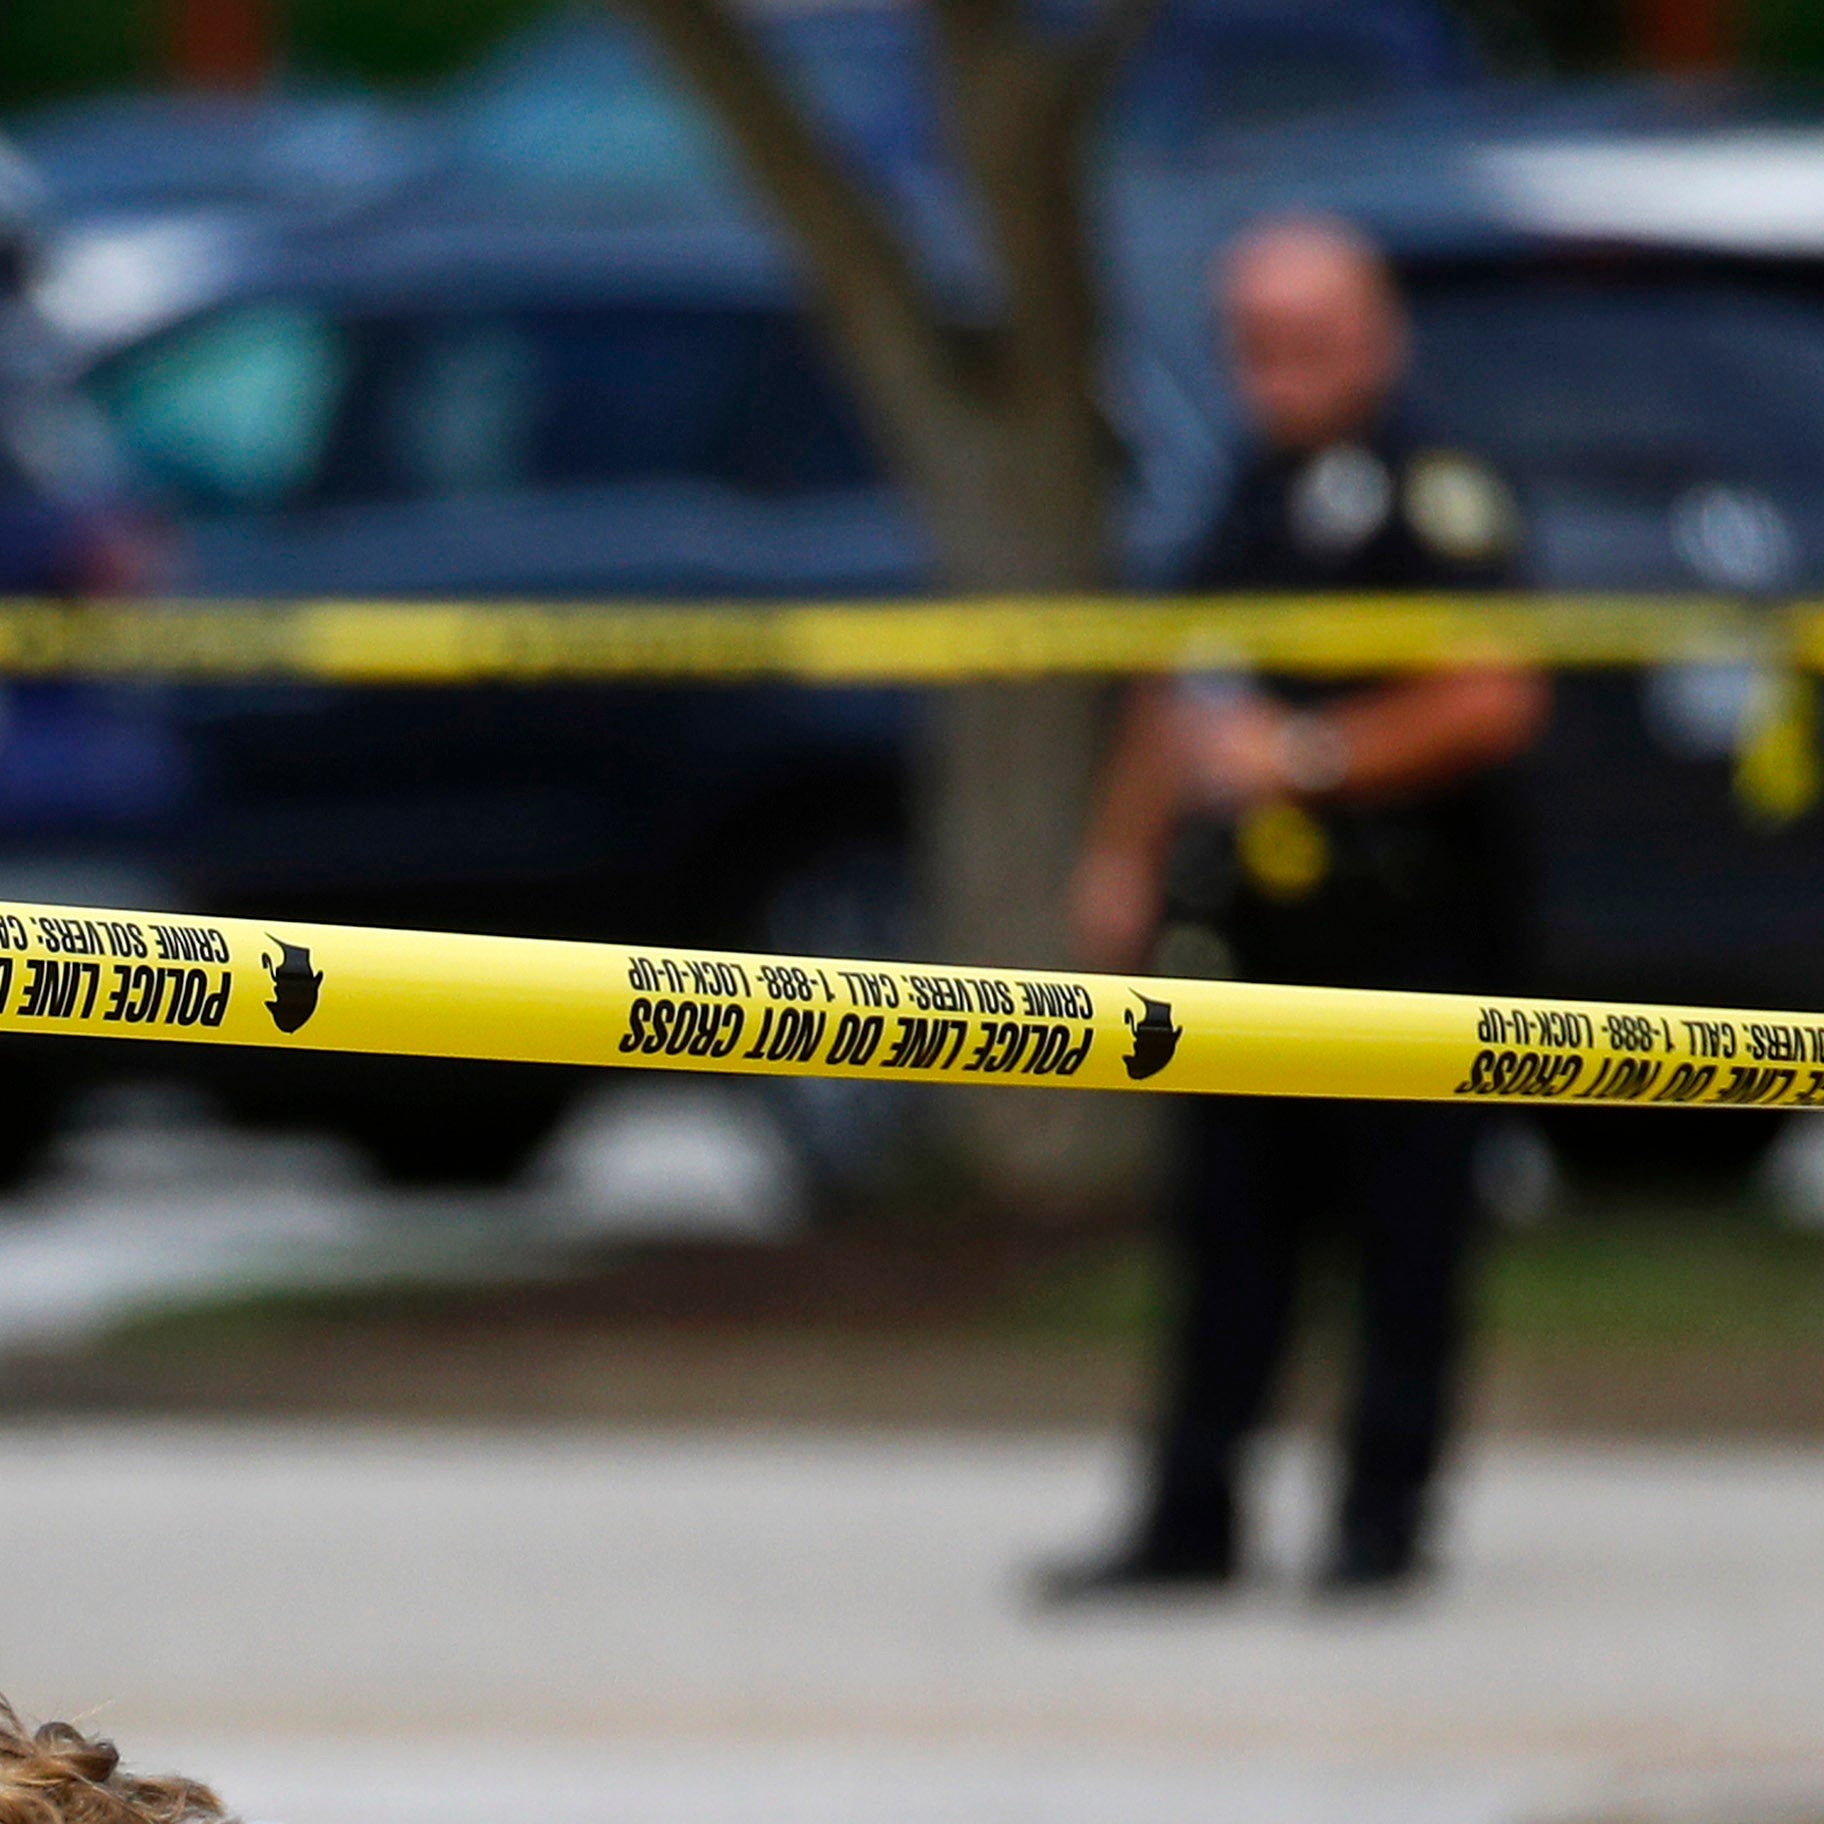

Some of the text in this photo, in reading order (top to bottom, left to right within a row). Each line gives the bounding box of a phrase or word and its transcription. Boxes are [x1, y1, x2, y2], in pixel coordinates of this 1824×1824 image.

[31, 917, 148, 959] SOLVERS:
[148, 925, 230, 964] CRIME
[16, 959, 100, 1019] LINE
[102, 964, 232, 1027] POLICE
[838, 972, 900, 1009] CALL
[902, 974, 1015, 1016] SOLVERS:
[1017, 982, 1094, 1020] CRIME
[618, 997, 1094, 1076] POLICE LINE DO NOT CROSS
[1680, 1020, 1736, 1059] CALL
[1454, 1049, 1584, 1098] CROSS
[1652, 1062, 1718, 1103] DO
